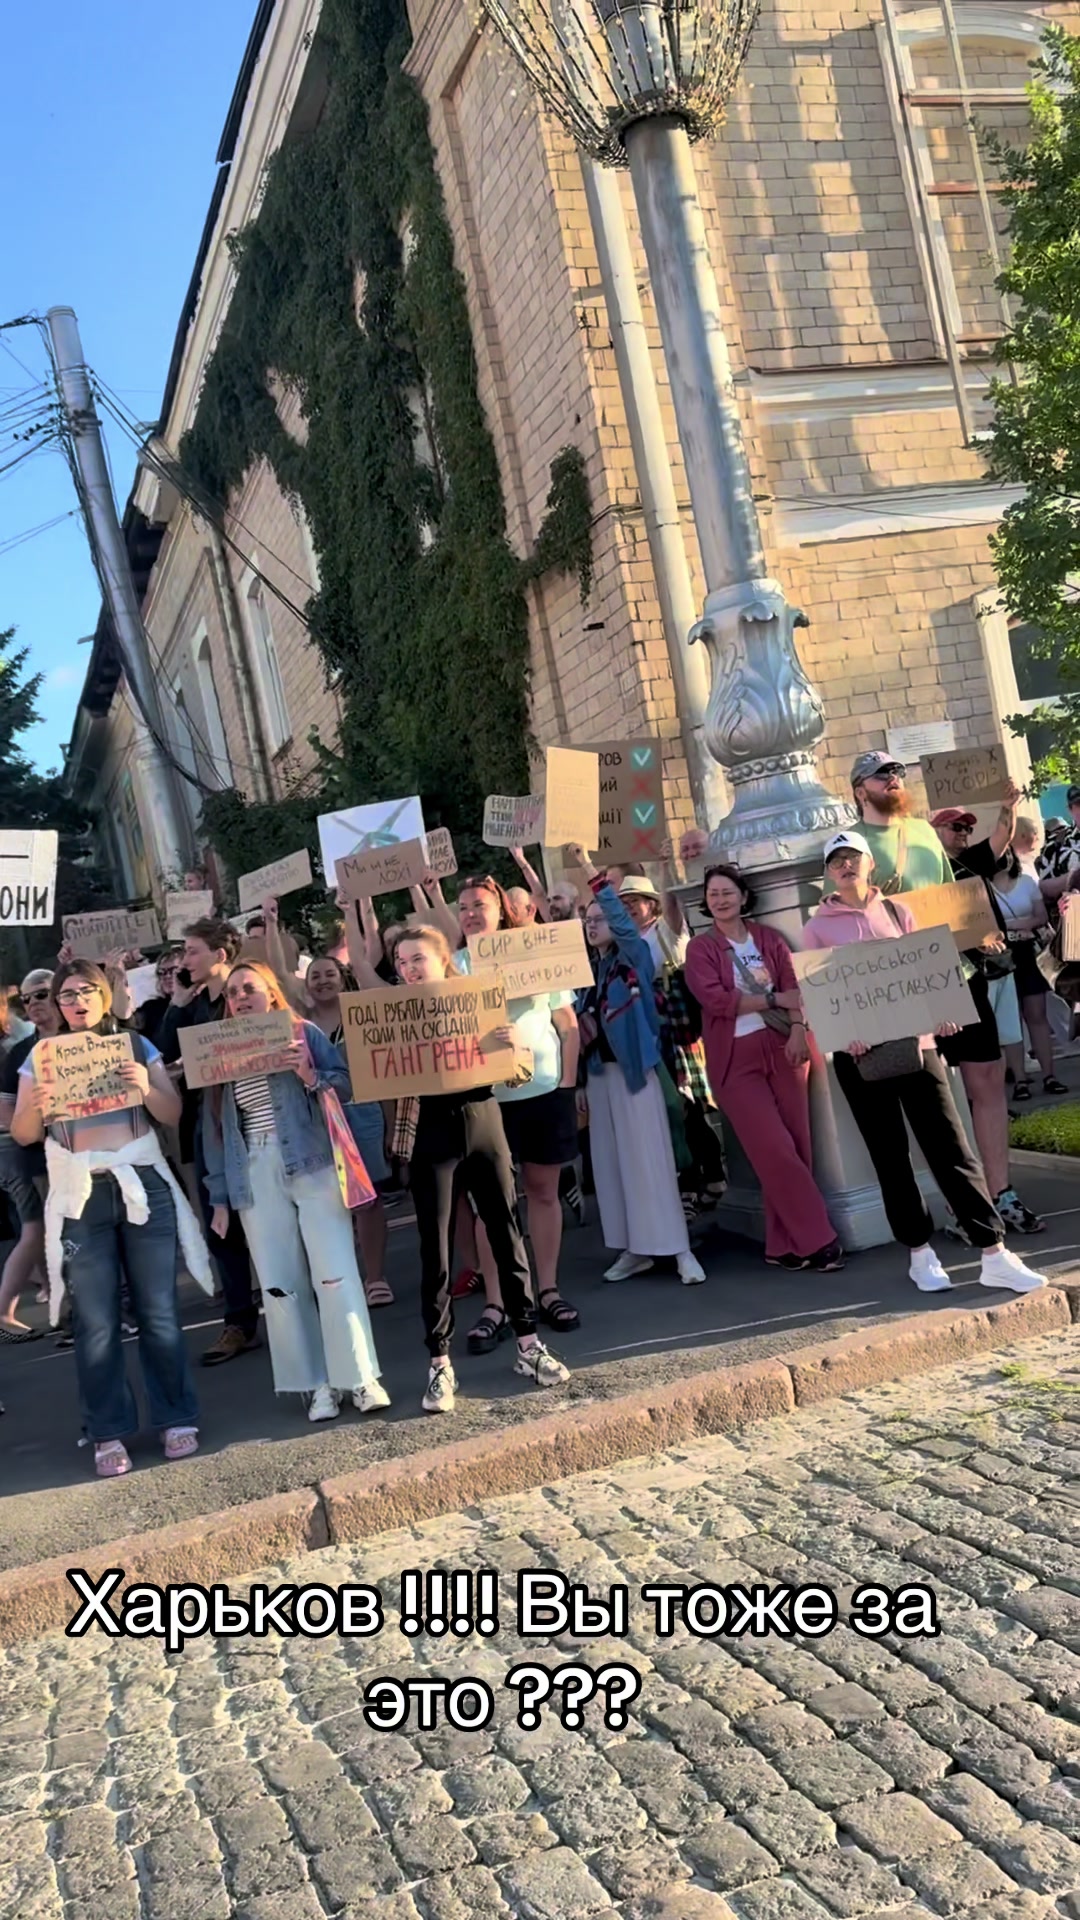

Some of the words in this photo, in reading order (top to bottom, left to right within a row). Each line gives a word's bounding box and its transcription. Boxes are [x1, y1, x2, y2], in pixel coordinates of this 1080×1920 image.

[478, 934, 512, 959] СИР
[522, 928, 560, 950] ВЖЕ
[348, 1001, 379, 1027] ГОДІ
[384, 997, 426, 1024] РУБАТИ
[427, 992, 479, 1016] ЗДОРОВУ
[362, 1025, 396, 1047] КОЛИ
[401, 1024, 419, 1044] НА
[370, 1035, 486, 1080] ГАНГРЕНА
